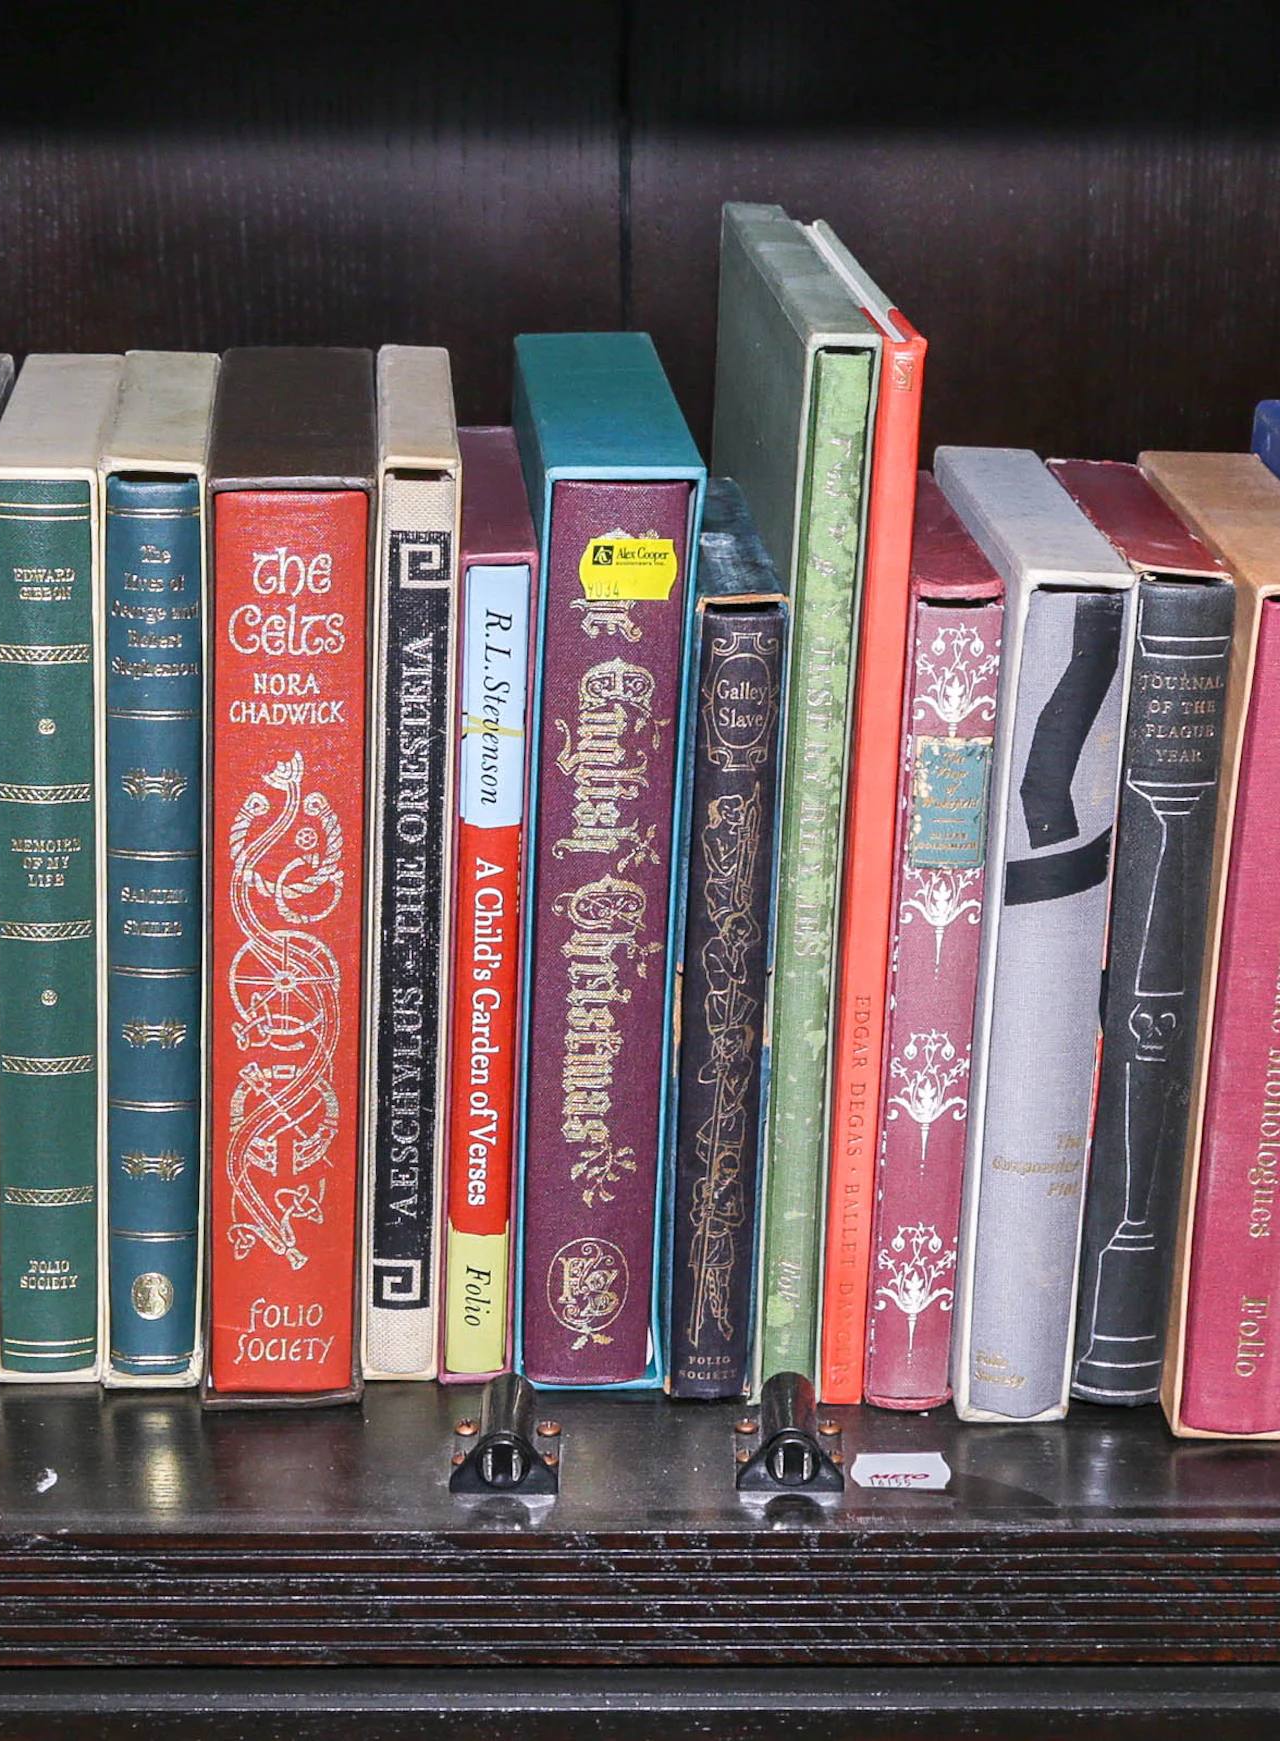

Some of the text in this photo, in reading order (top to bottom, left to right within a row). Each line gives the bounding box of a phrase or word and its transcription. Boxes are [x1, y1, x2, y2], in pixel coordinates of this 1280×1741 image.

[616, 546, 669, 562] Alex Cooper
[13, 568, 75, 583] EDWARD
[228, 603, 347, 656] Celts
[253, 672, 320, 696] NORA
[716, 678, 768, 703] Galley
[1139, 673, 1224, 691] JOURNAL
[228, 700, 345, 725] CHADWICK
[719, 706, 765, 729] Slave
[1149, 700, 1217, 715] OF THE
[394, 634, 434, 845] ORESTEIA
[1145, 723, 1215, 739] PLAGUE
[552, 656, 658, 862] English
[1156, 748, 1202, 763] YEAR
[11, 838, 81, 853] MEMOIRS
[23, 856, 70, 870] OF MY
[28, 873, 65, 888] LIFE
[552, 873, 648, 1144] Christmas
[466, 856, 505, 1207] A Child's Garden of Verses
[851, 995, 873, 1070] EDGAR
[390, 985, 424, 1220] AESCHYLUS
[845, 1082, 867, 1157] DEGAS
[840, 1182, 861, 1269] BALLET
[29, 1260, 70, 1275] FOLIO
[20, 1273, 78, 1290] SOCIETY
[462, 1264, 491, 1328] Folio
[1234, 1295, 1271, 1378] Folio
[233, 1334, 335, 1365] SOCIETY
[688, 1355, 731, 1366] FOLIO
